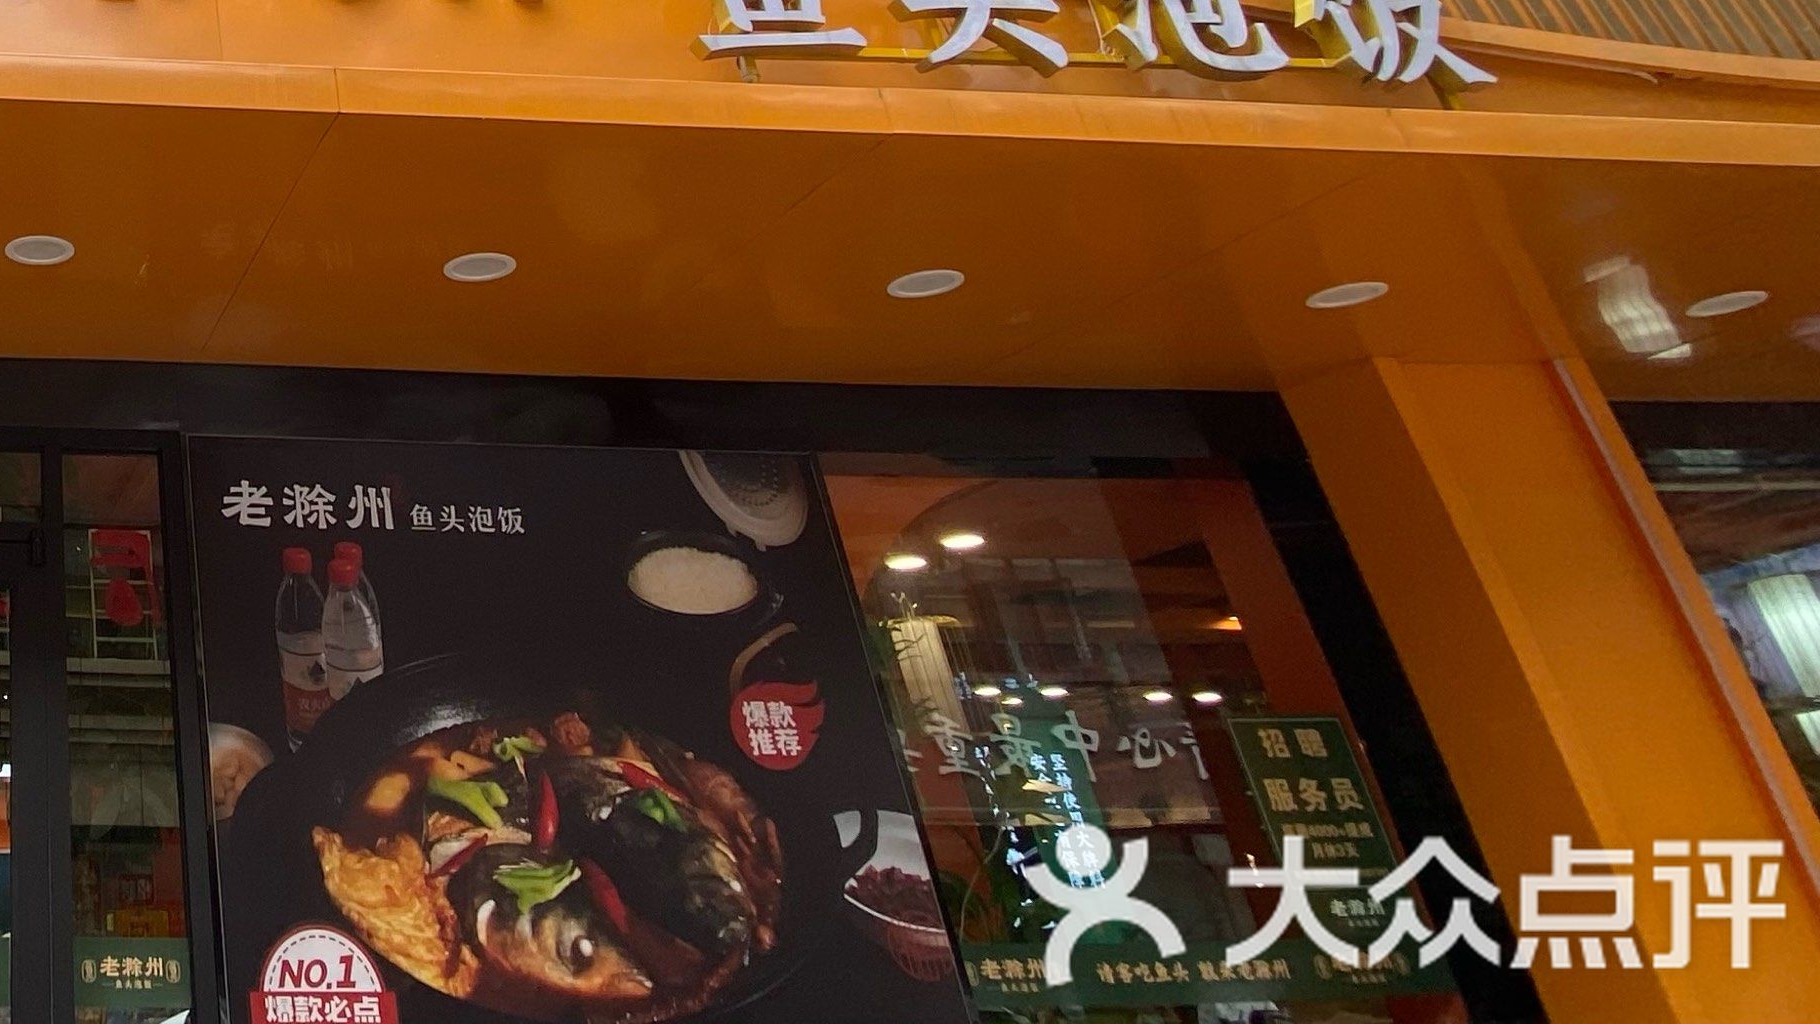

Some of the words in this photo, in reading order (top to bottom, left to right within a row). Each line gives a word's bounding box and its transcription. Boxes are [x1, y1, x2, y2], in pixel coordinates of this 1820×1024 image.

[221, 479, 395, 530] 老滁州
[409, 503, 526, 534] 鱼头泡饭
[742, 700, 797, 728] 爆款
[747, 728, 803, 756] 推荐
[1257, 728, 1329, 758] 招聘
[1263, 777, 1366, 812] 服务员
[99, 955, 164, 977] 老滁州
[279, 953, 357, 990] NO.1
[264, 996, 382, 1023] 爆款必点
